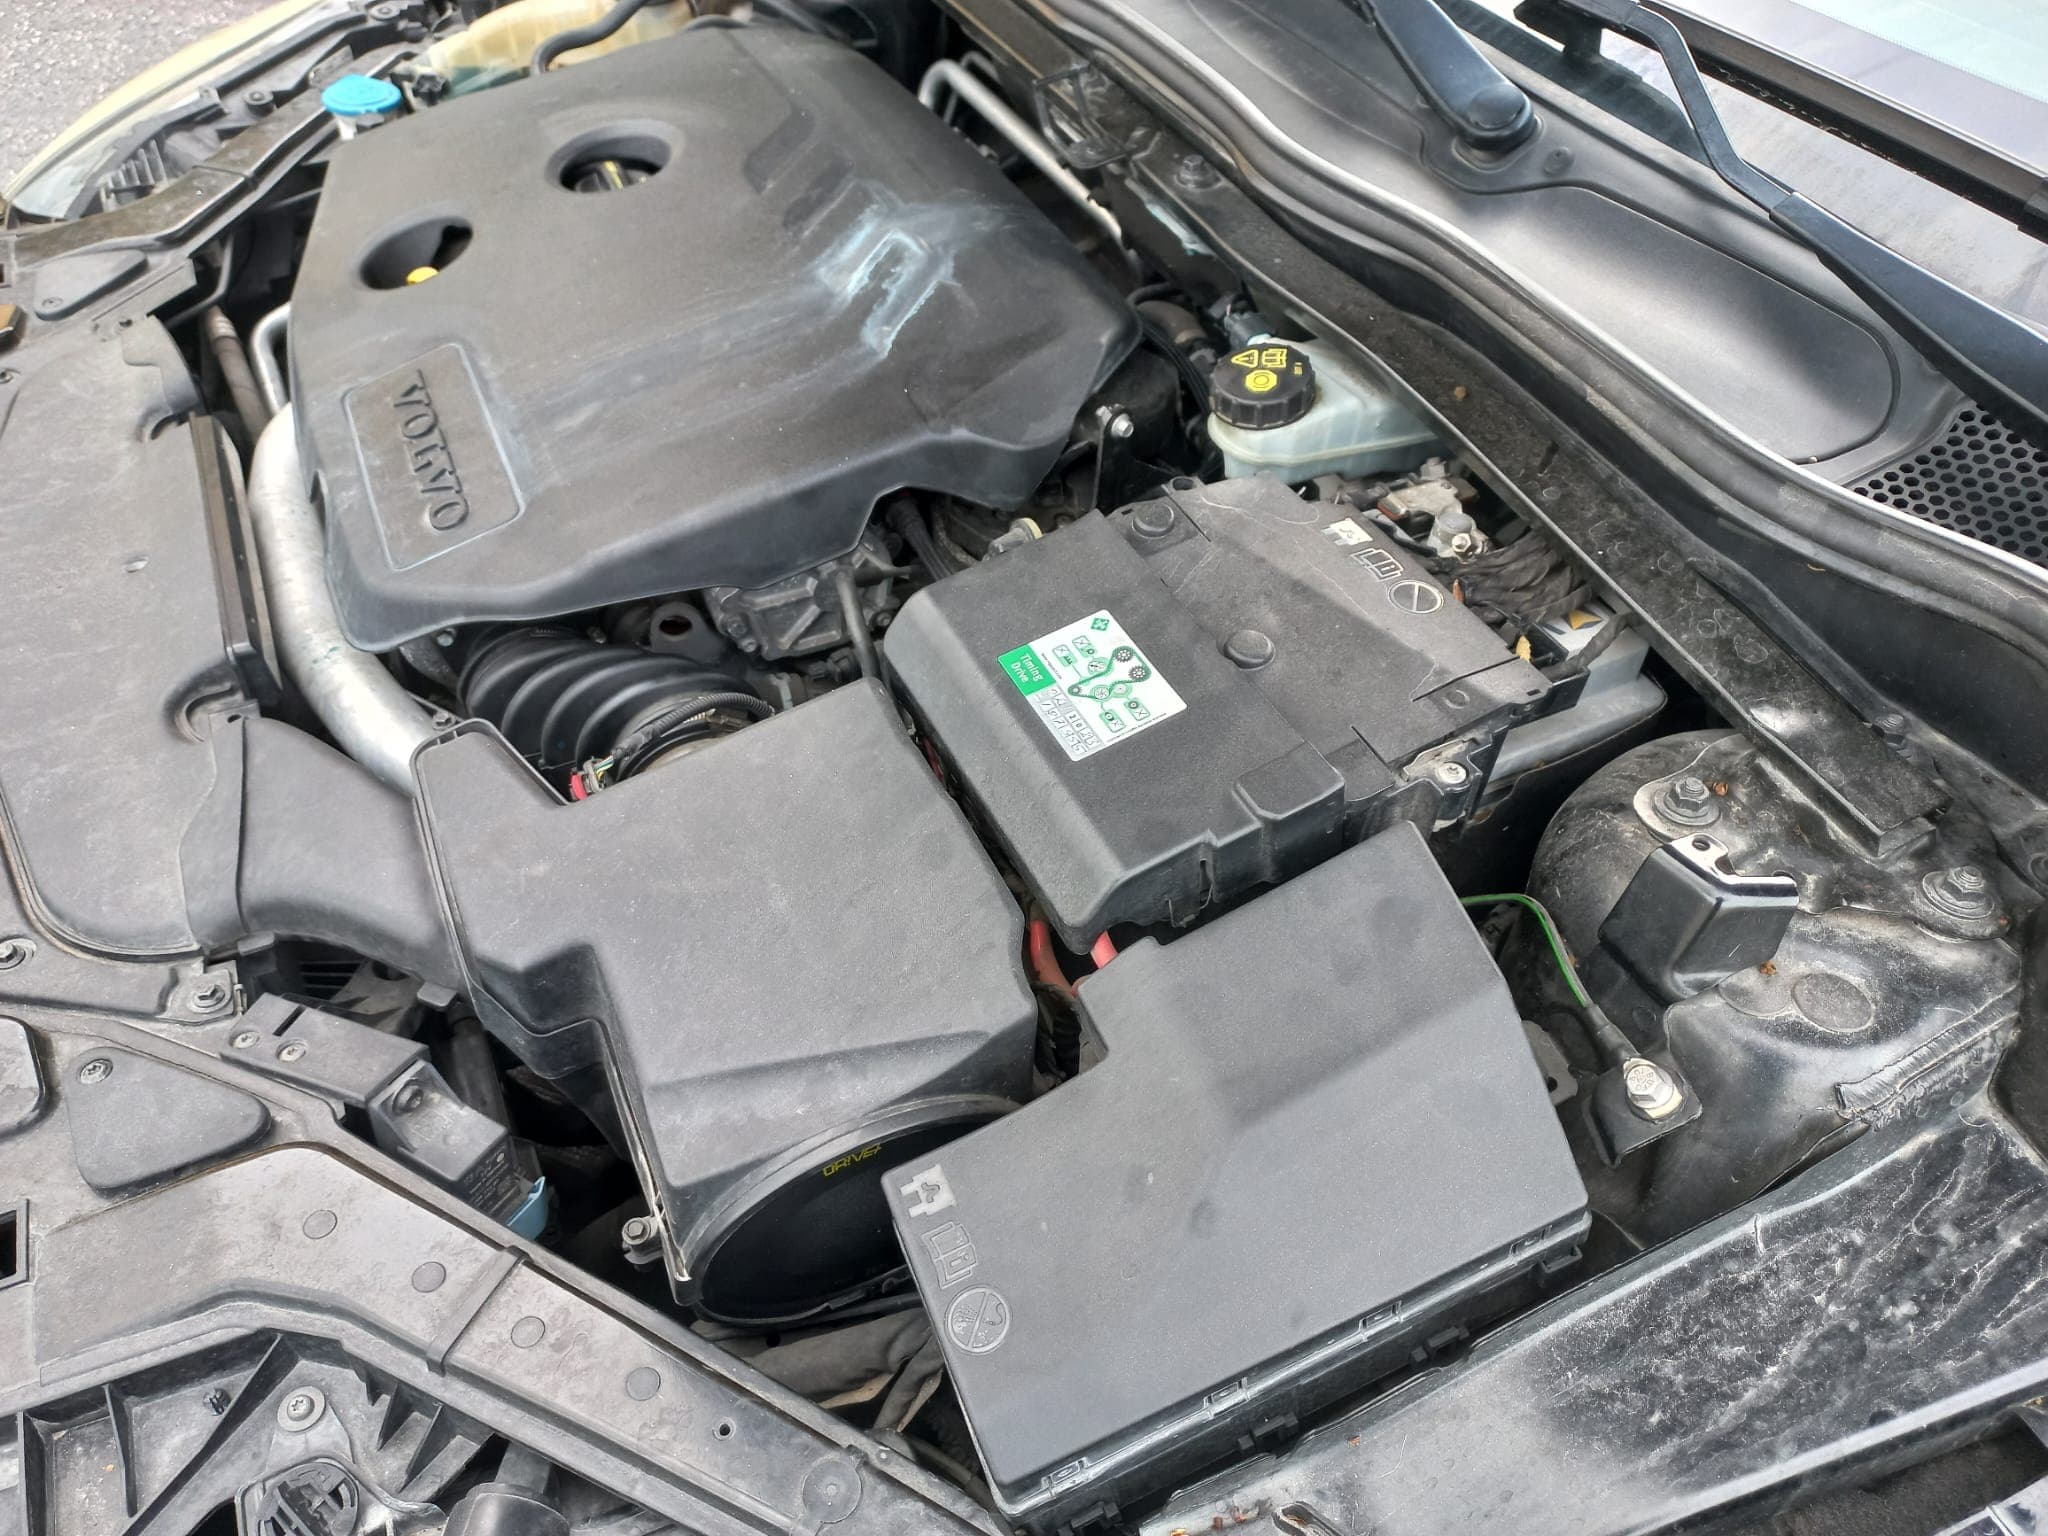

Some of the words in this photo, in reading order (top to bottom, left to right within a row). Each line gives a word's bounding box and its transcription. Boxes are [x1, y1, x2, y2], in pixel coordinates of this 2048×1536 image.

[393, 368, 470, 532] VOLVO
[1010, 662, 1030, 683] Drive
[1018, 653, 1045, 682] Timing
